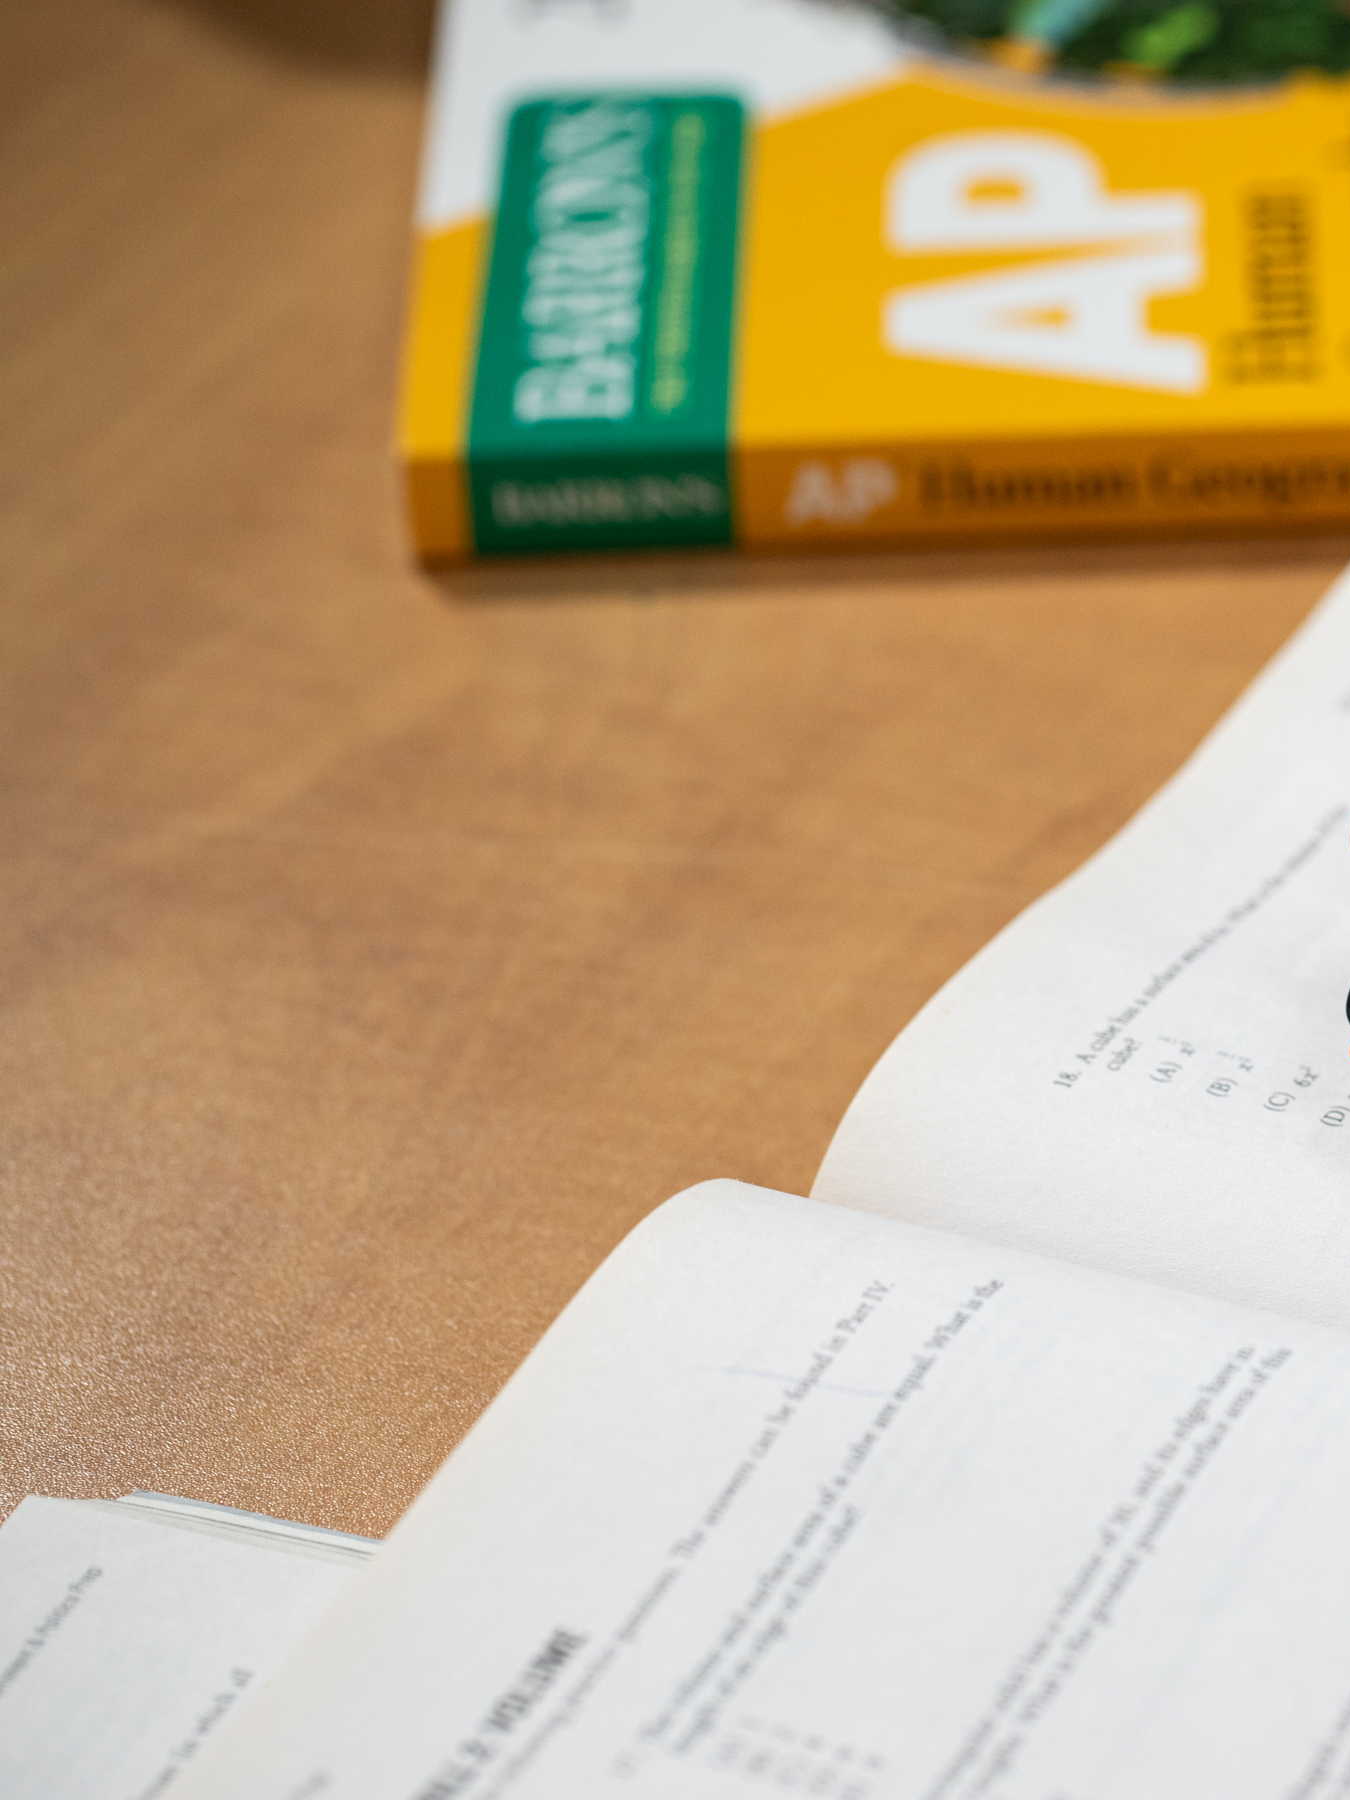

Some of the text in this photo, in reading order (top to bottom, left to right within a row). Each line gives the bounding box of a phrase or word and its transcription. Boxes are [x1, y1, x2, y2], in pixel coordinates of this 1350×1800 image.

[881, 128, 1204, 392] AP
[785, 458, 897, 527] AP
[918, 455, 1136, 514] Human
[1053, 1071, 1082, 1088] 18.
[1076, 1053, 1097, 1065] A
[1090, 1025, 1122, 1051] cube
[1107, 1038, 1142, 1072] cube?
[1149, 1061, 1183, 1082] (A)
[1206, 1078, 1239, 1097] (B)
[1263, 1091, 1296, 1112] (C)
[924, 1311, 972, 1349] What
[960, 1299, 983, 1312] is
[974, 1279, 1005, 1298] the
[750, 1427, 778, 1460] can
[765, 1403, 797, 1425] be
[783, 1351, 834, 1402] found
[822, 1334, 848, 1353] in
[835, 1302, 875, 1333] Part
[862, 1280, 895, 1302] IV.
[1198, 1362, 1241, 1396] have
